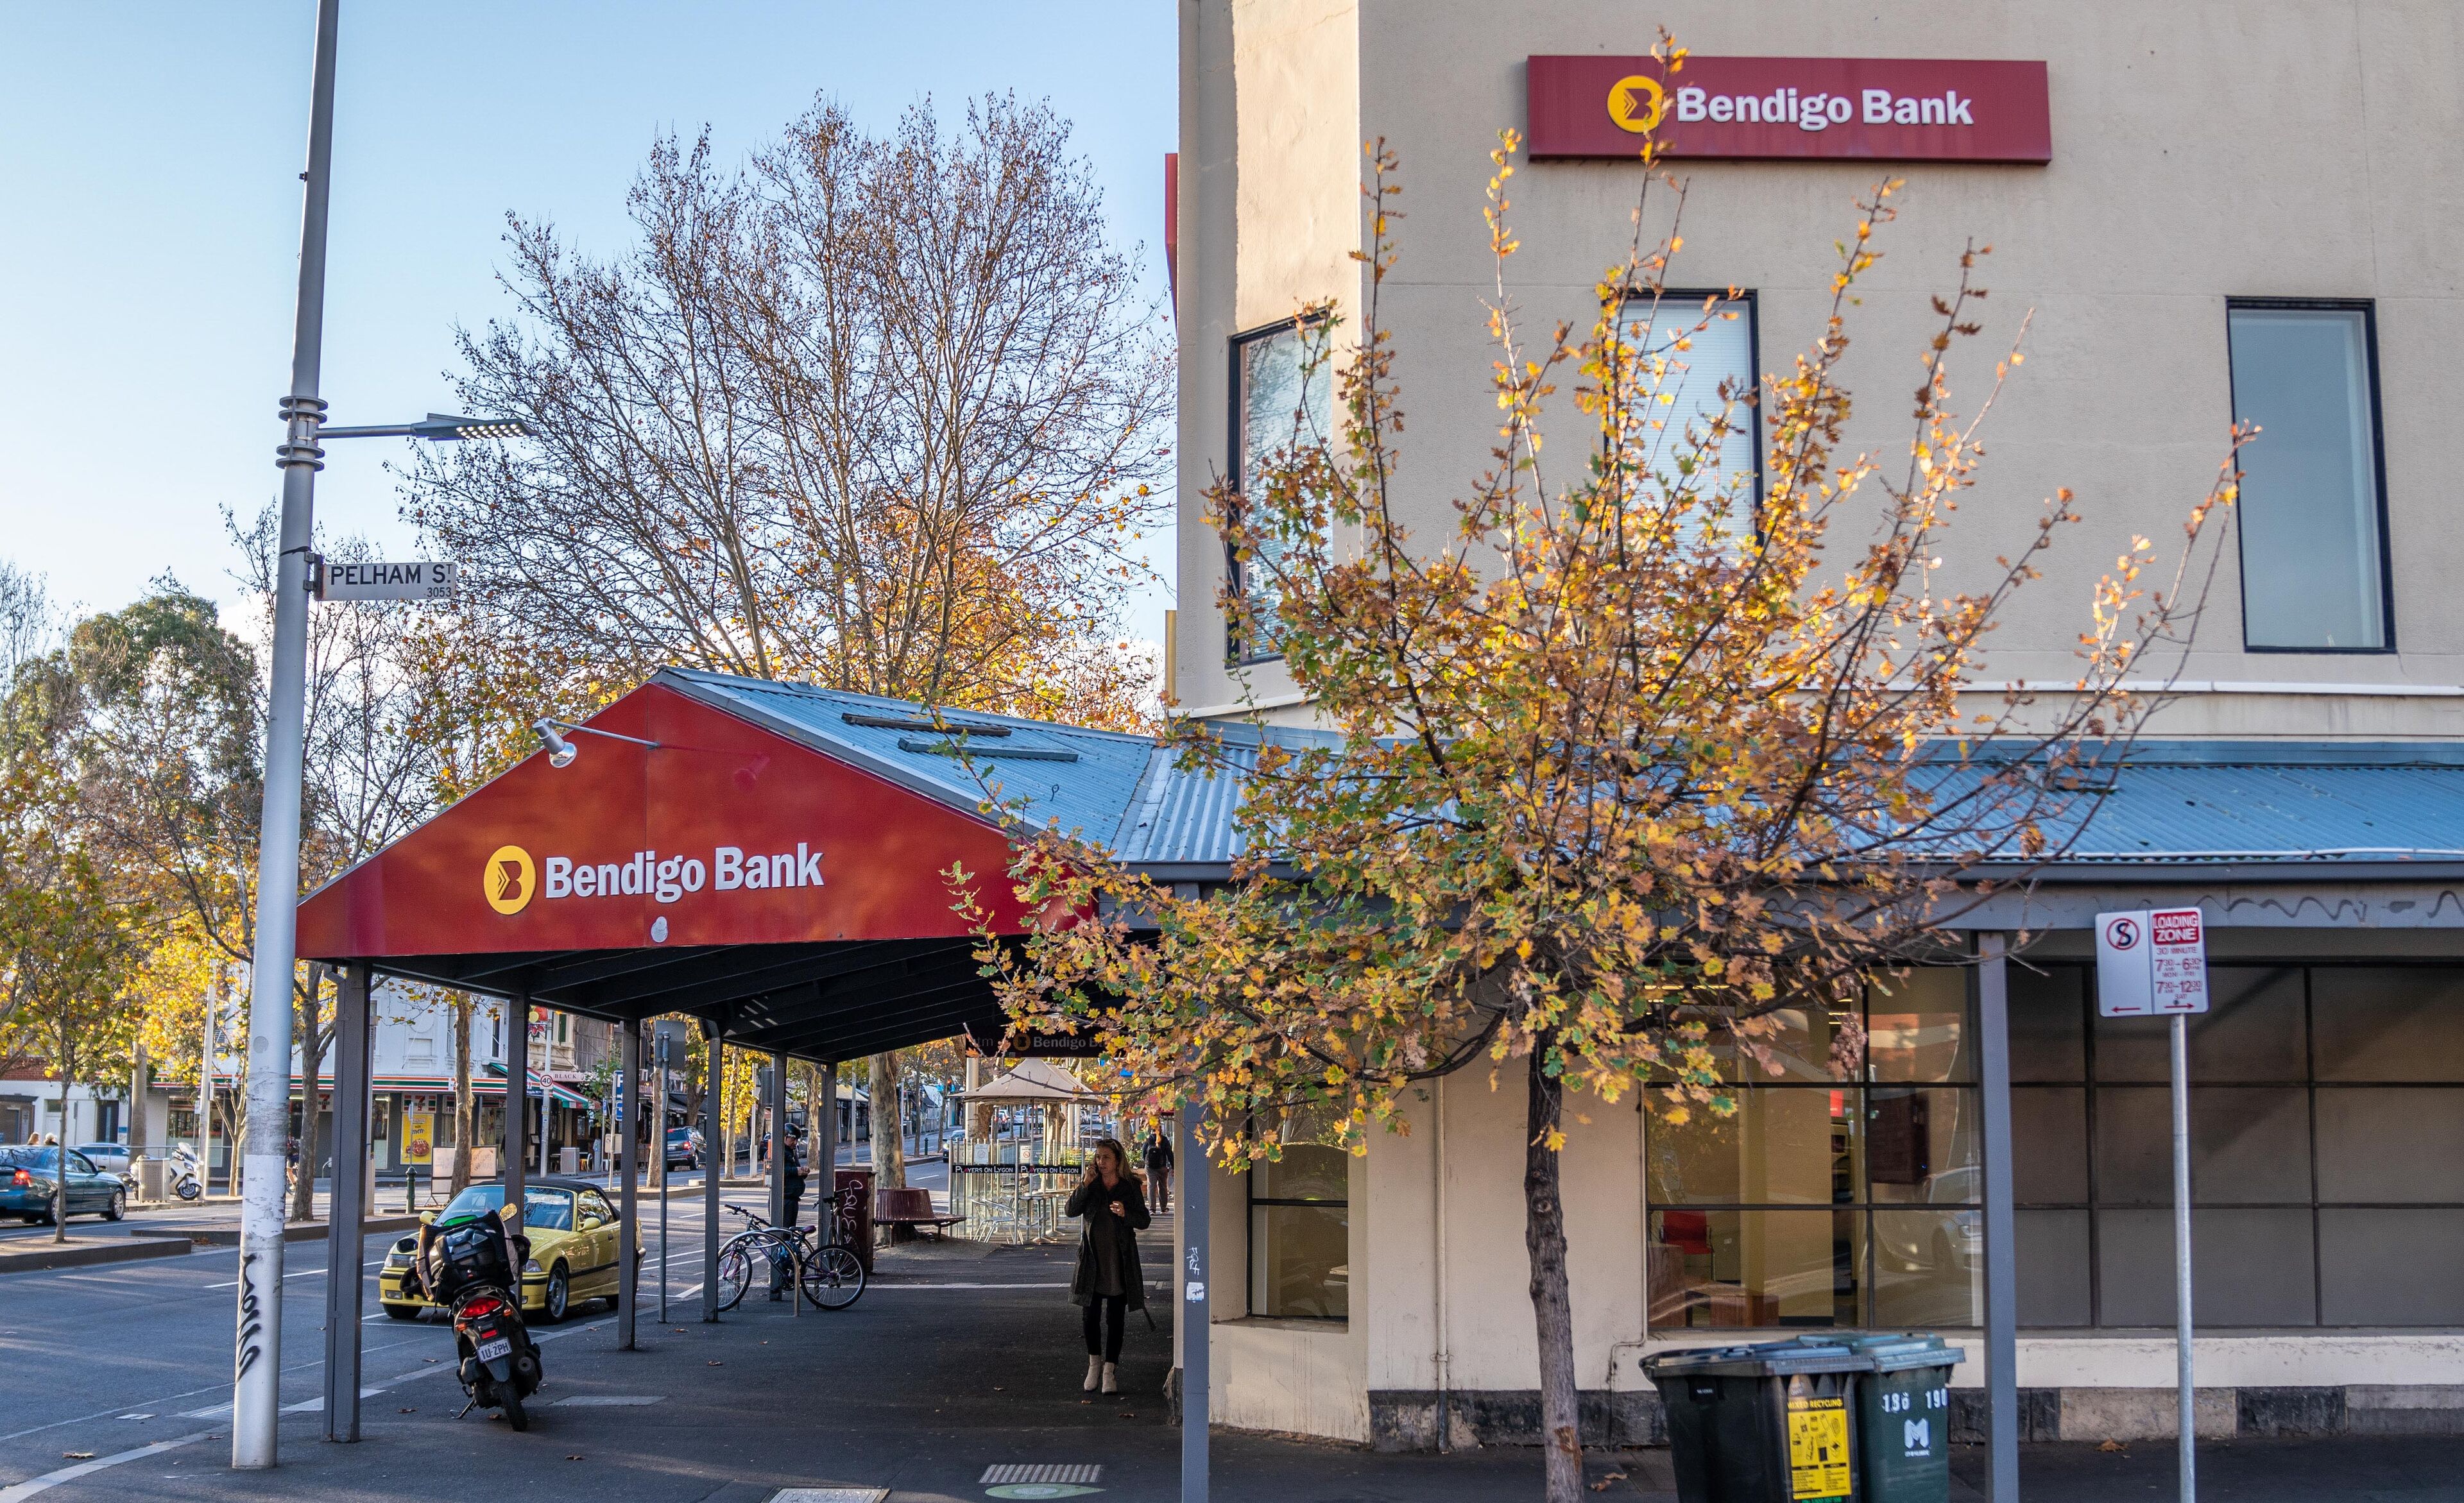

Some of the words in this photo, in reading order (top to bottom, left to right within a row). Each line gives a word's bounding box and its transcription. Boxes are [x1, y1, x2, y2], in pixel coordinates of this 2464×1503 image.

[1676, 86, 1854, 132] Bendigo
[1861, 88, 1975, 126] Bank
[330, 565, 422, 586] PELHAM
[427, 587, 452, 598] 3053
[545, 850, 706, 904] Bendigo
[715, 842, 825, 890] Bank
[2153, 915, 2198, 930] LOADING
[2156, 928, 2197, 942] ZONE
[2171, 946, 2197, 955] MINUTE
[1033, 1036, 1086, 1050] Bendigo
[481, 1342, 509, 1359] 1U-2PH
[1810, 1398, 1843, 1408] RECYCLING
[1925, 1388, 1947, 1409] 190
